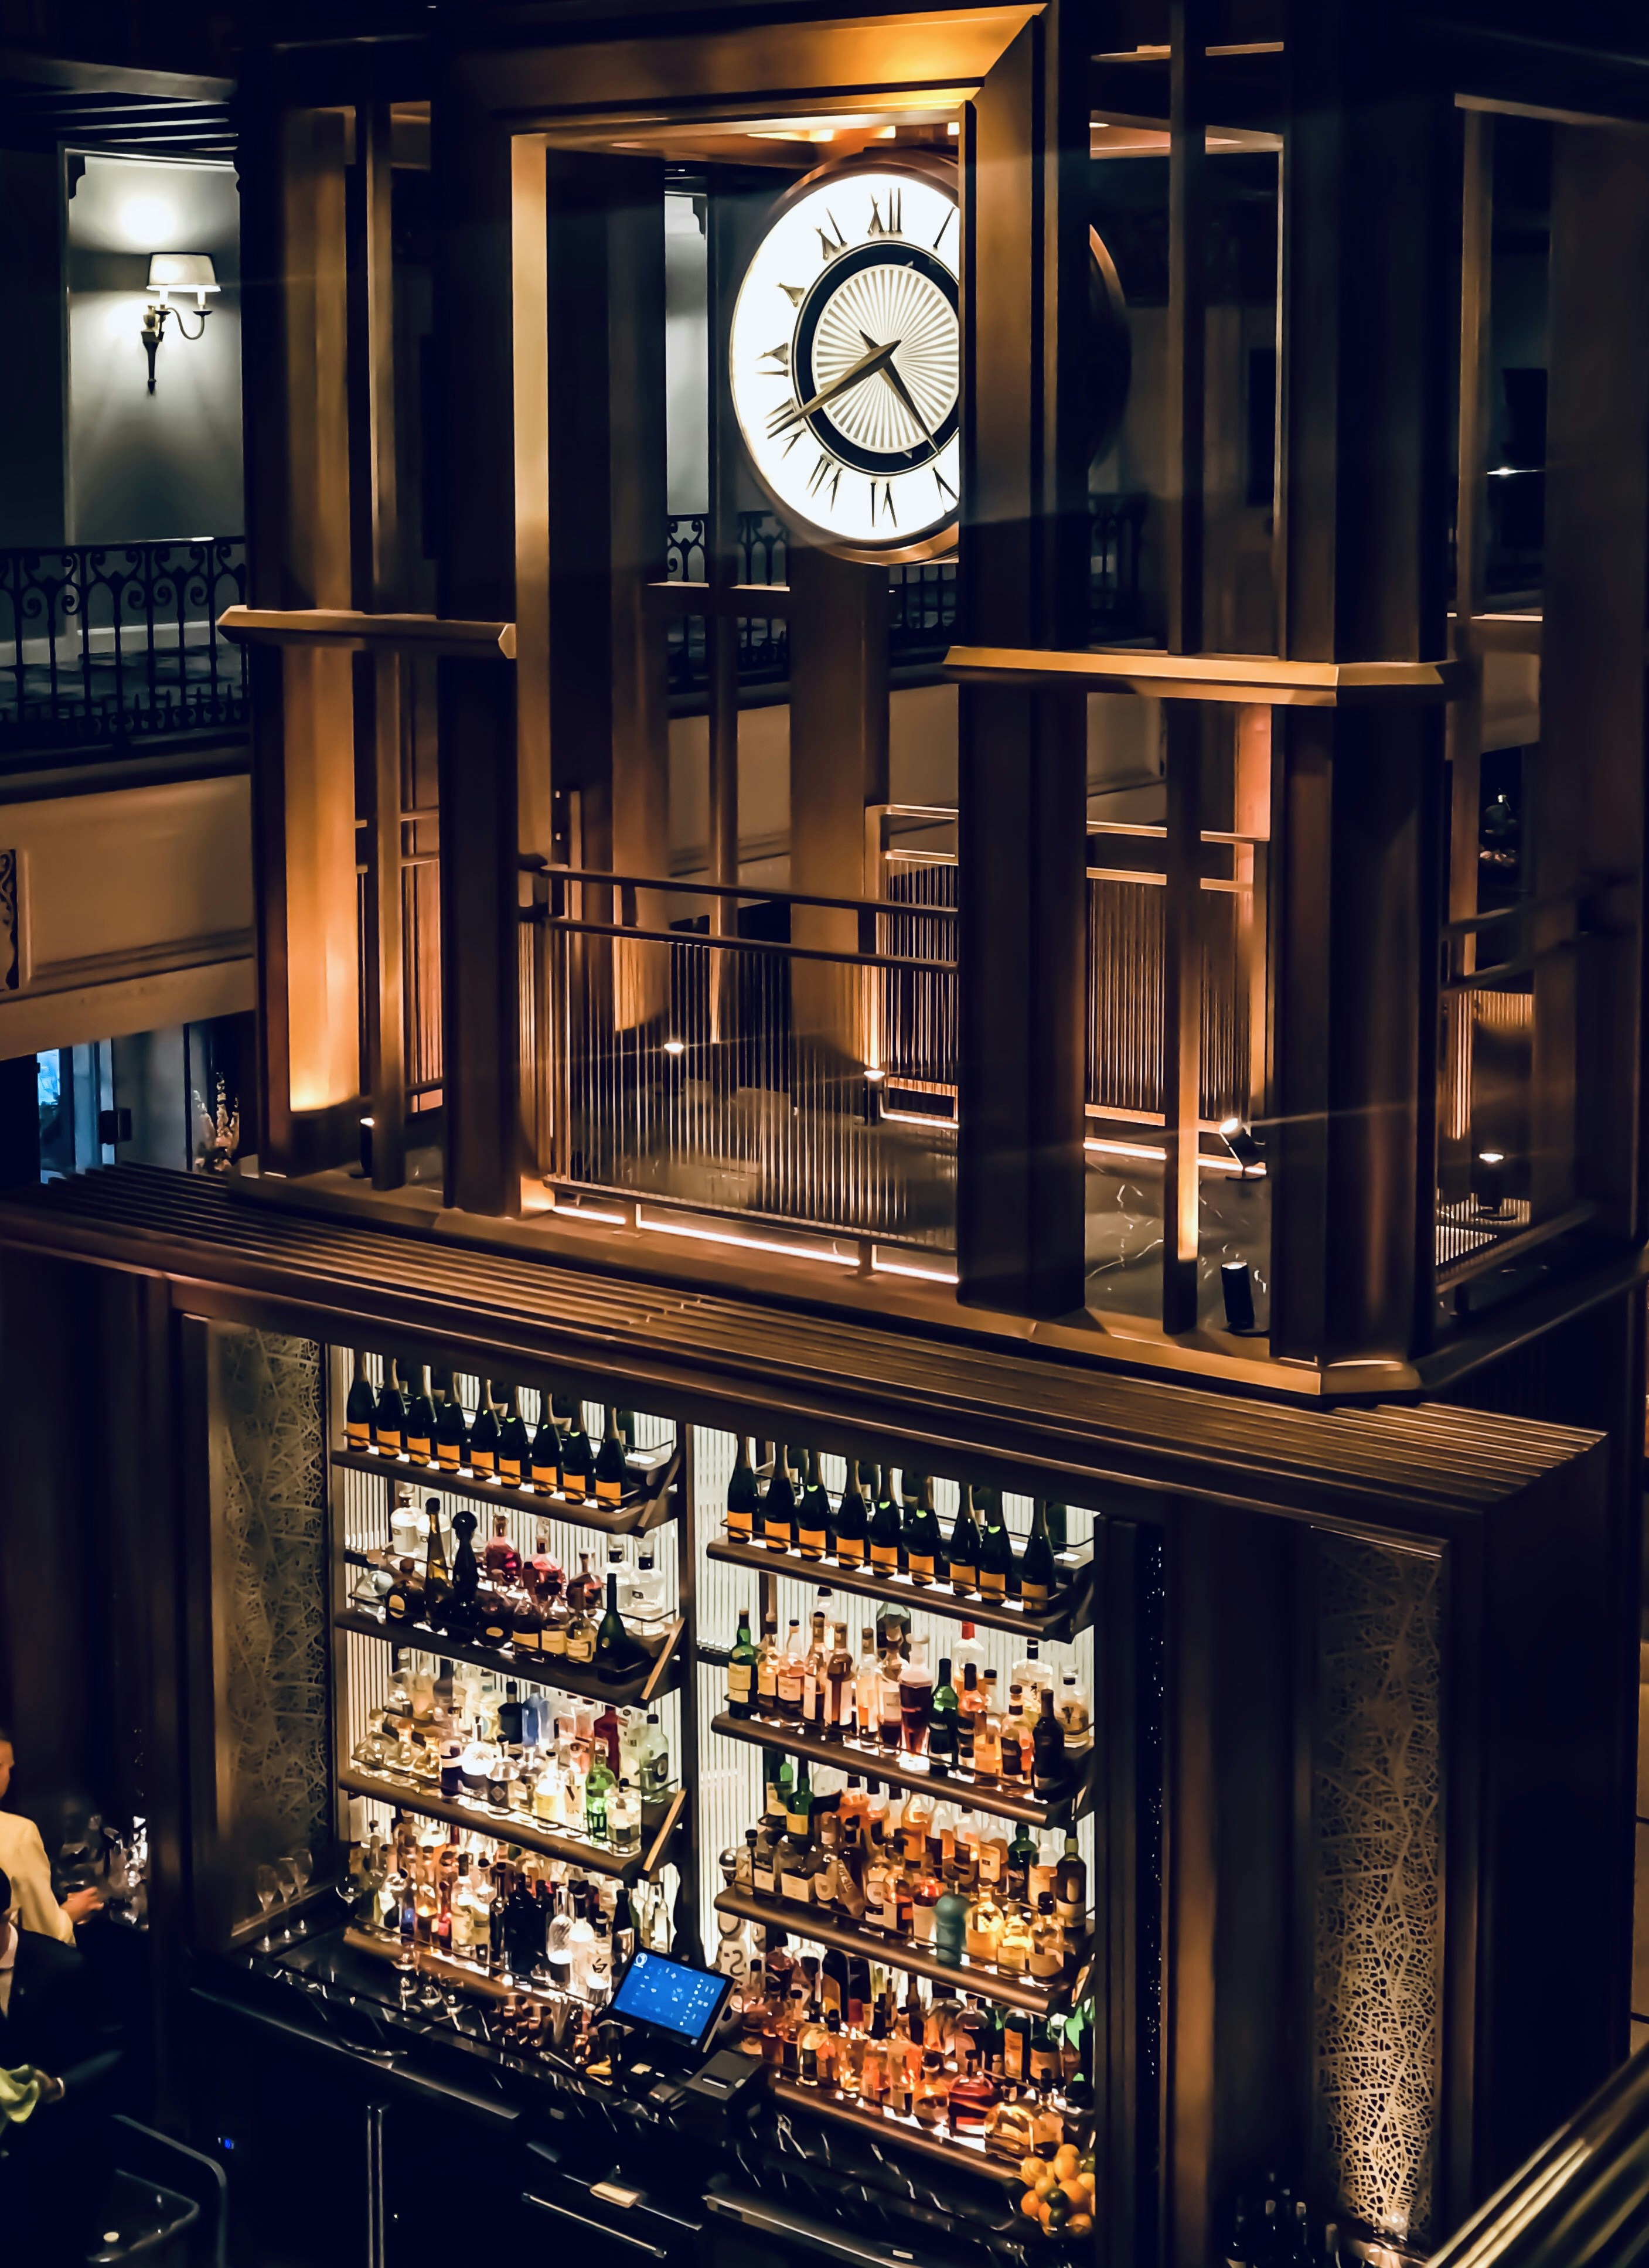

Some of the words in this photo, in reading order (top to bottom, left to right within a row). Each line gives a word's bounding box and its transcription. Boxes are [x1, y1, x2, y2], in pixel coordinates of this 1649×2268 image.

[815, 207, 847, 260] XI
[867, 188, 903, 236] XII
[932, 205, 956, 250] I
[754, 343, 789, 377] IX
[806, 454, 843, 512] VII
[871, 482, 898, 527] VI
